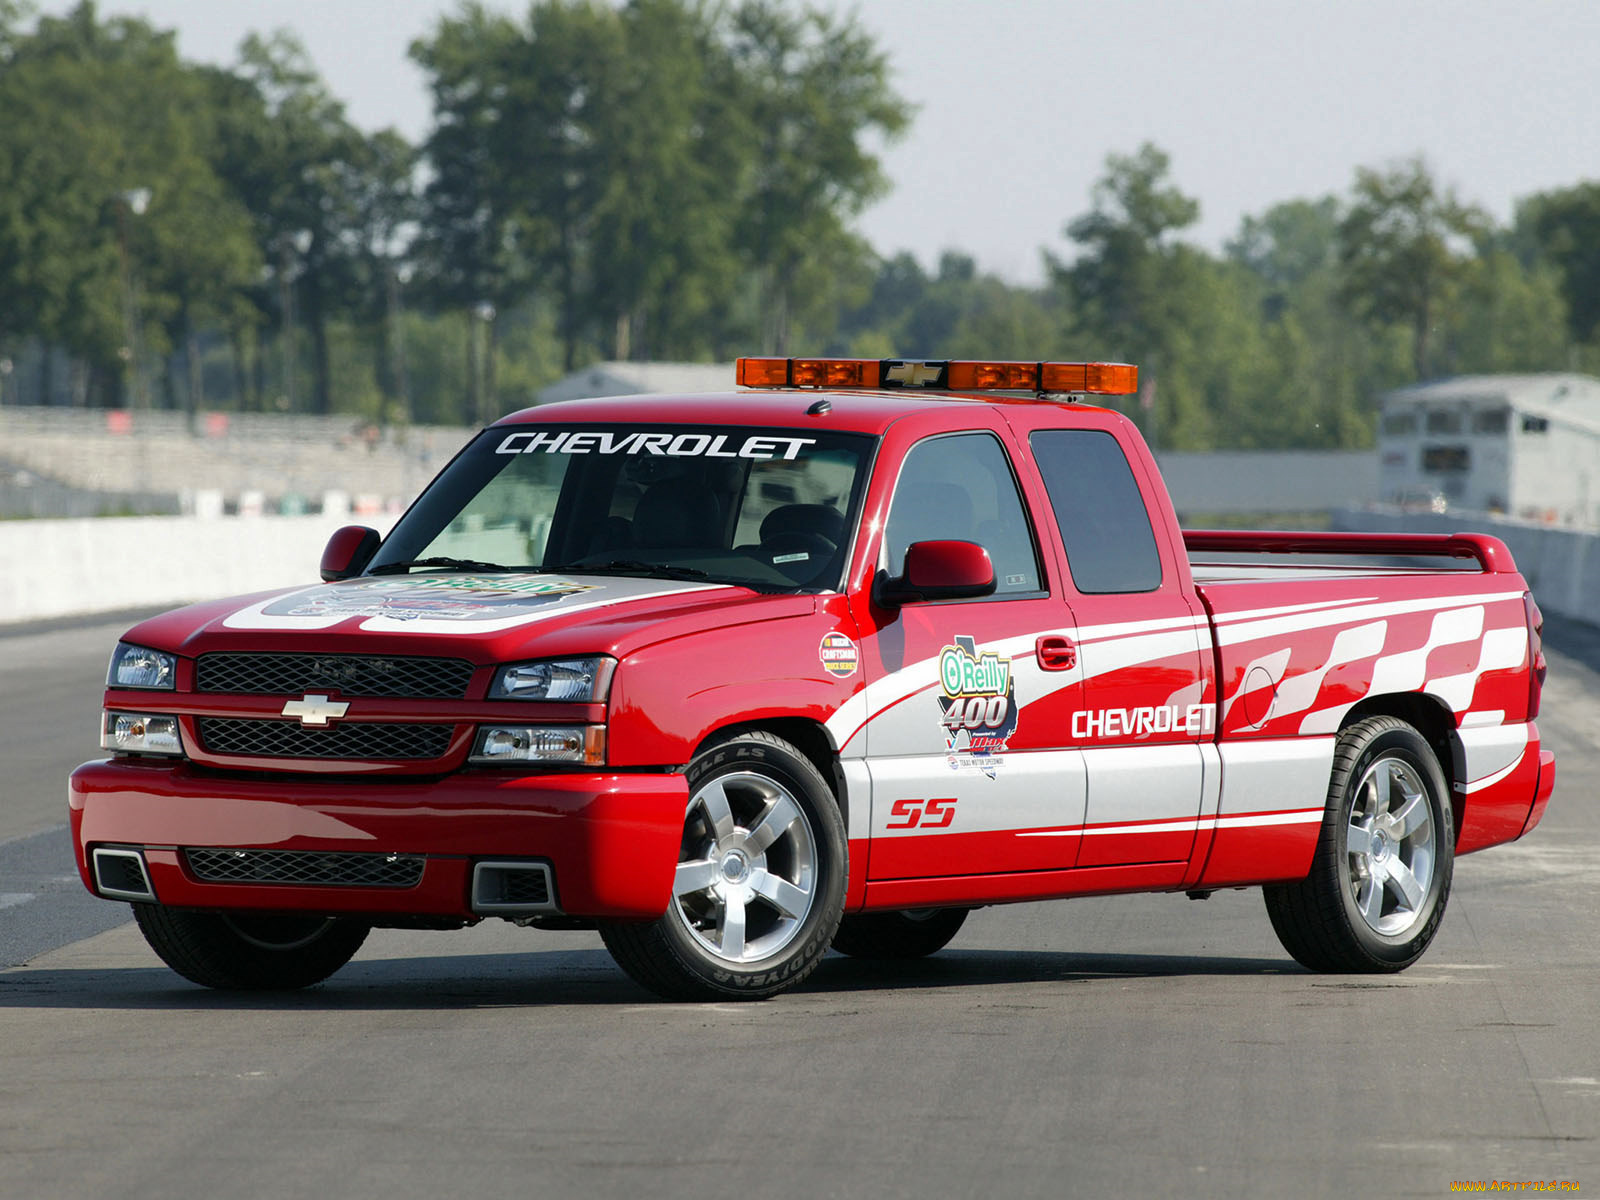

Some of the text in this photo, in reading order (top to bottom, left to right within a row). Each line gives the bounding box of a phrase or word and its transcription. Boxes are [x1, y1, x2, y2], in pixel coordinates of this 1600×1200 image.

[495, 432, 817, 460] CHEVROLET
[944, 654, 1006, 693] O'Reilly
[942, 696, 1008, 730] 400
[1071, 703, 1217, 738] CHEVROLET
[688, 747, 766, 783] GLE LS
[886, 798, 958, 829] SS
